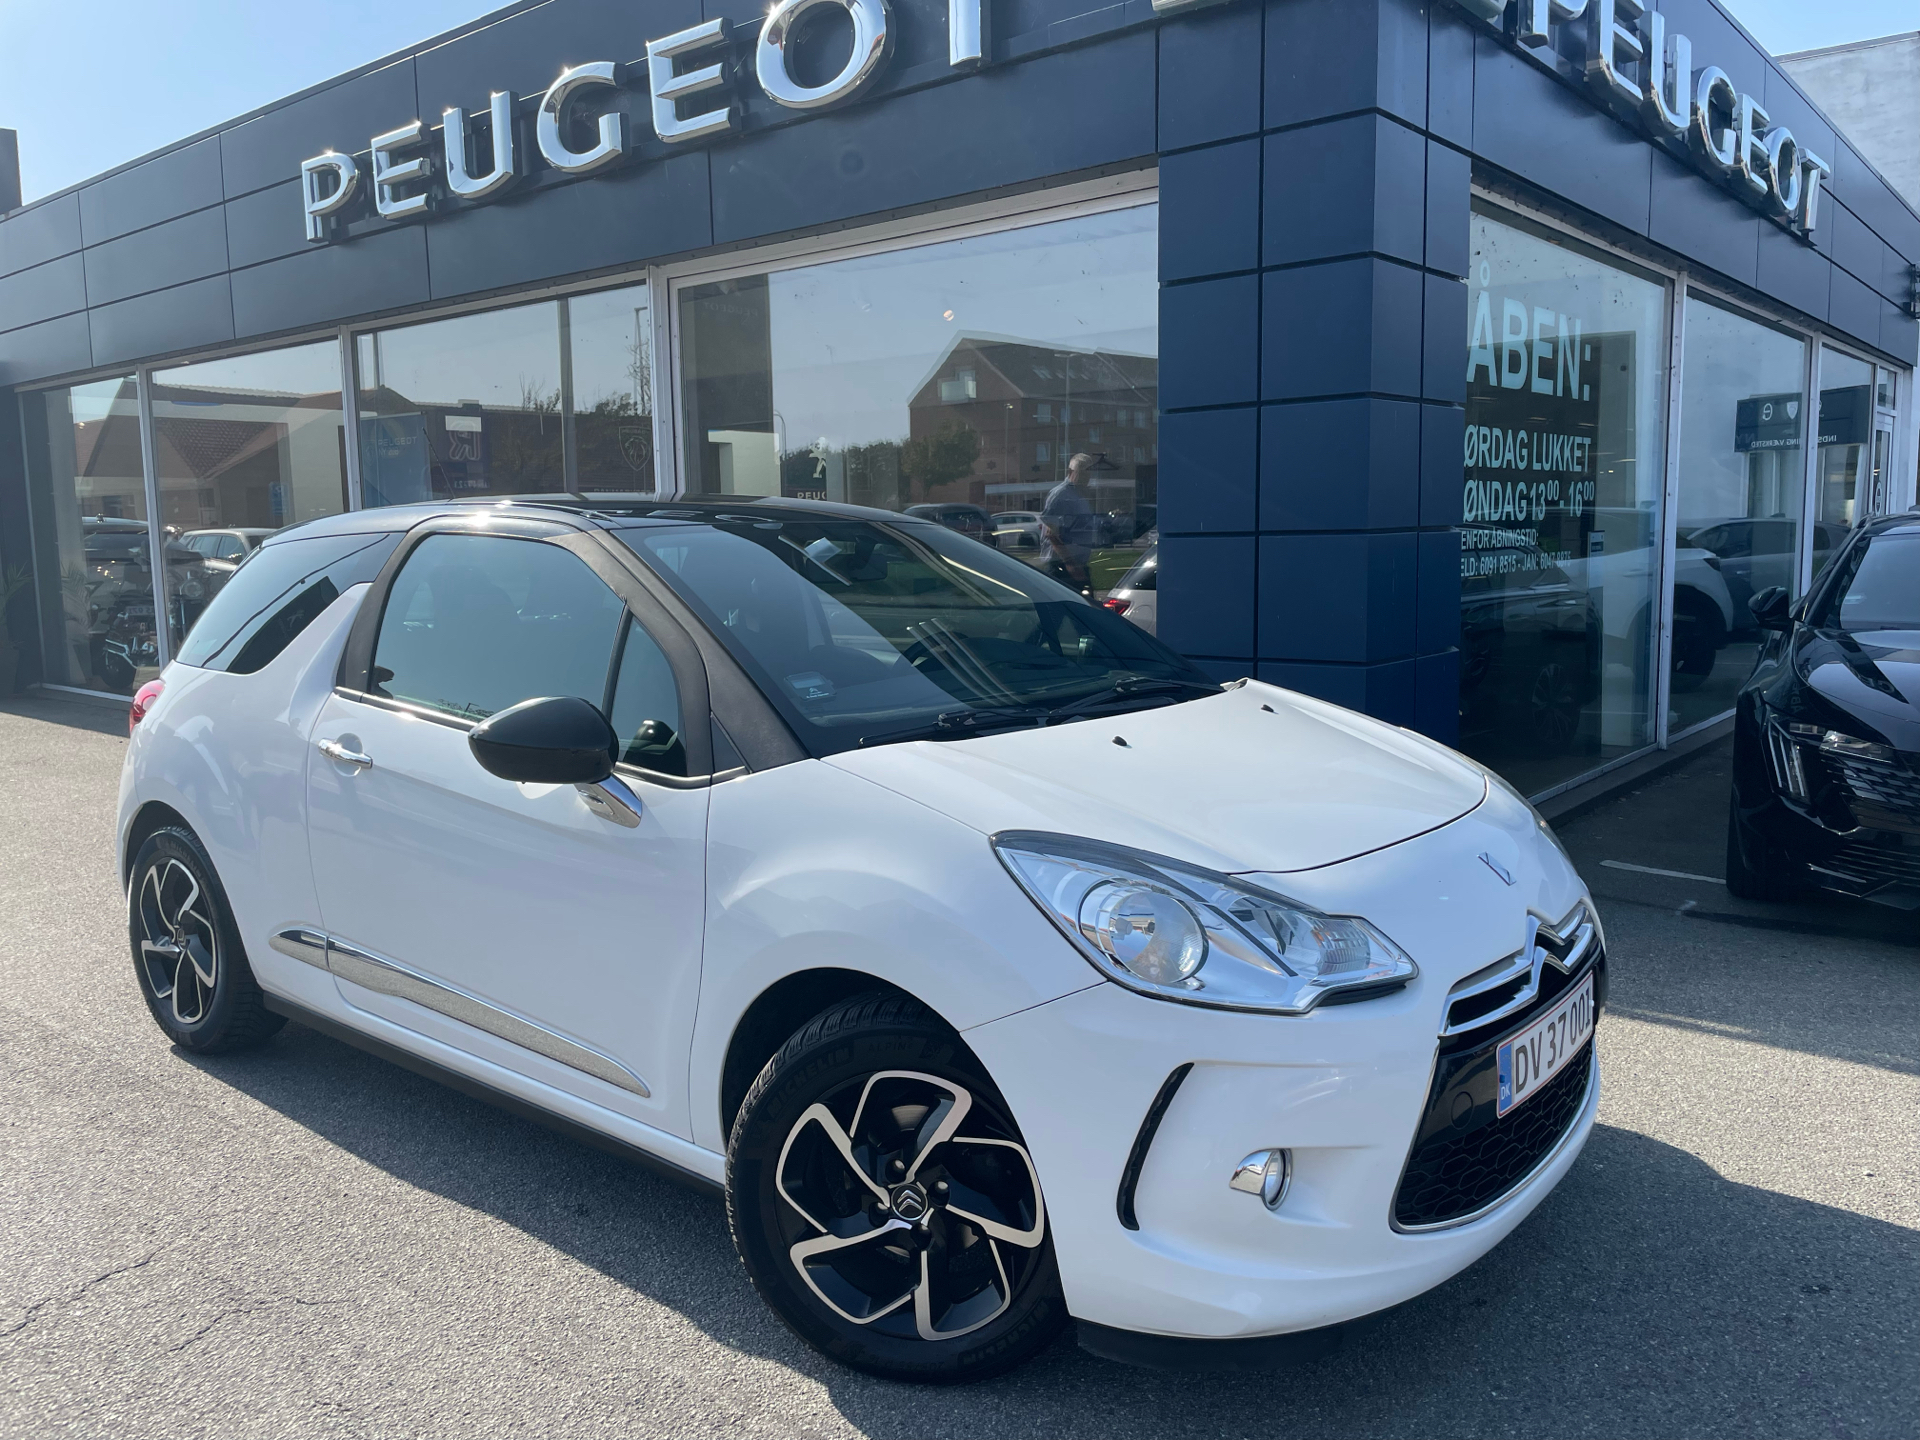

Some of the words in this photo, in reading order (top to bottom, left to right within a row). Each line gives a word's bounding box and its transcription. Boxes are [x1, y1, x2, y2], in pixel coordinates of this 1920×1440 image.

[1466, 259, 1591, 401] ÅBEN:
[1532, 432, 1591, 473] LUKKET
[1522, 553, 1539, 572] JAN:
[1515, 1030, 1543, 1094] DV
[1547, 1011, 1567, 1070] 37
[1570, 986, 1592, 1046] 001
[767, 1047, 850, 1118] MICHELIN
[1500, 1086, 1510, 1101] DK
